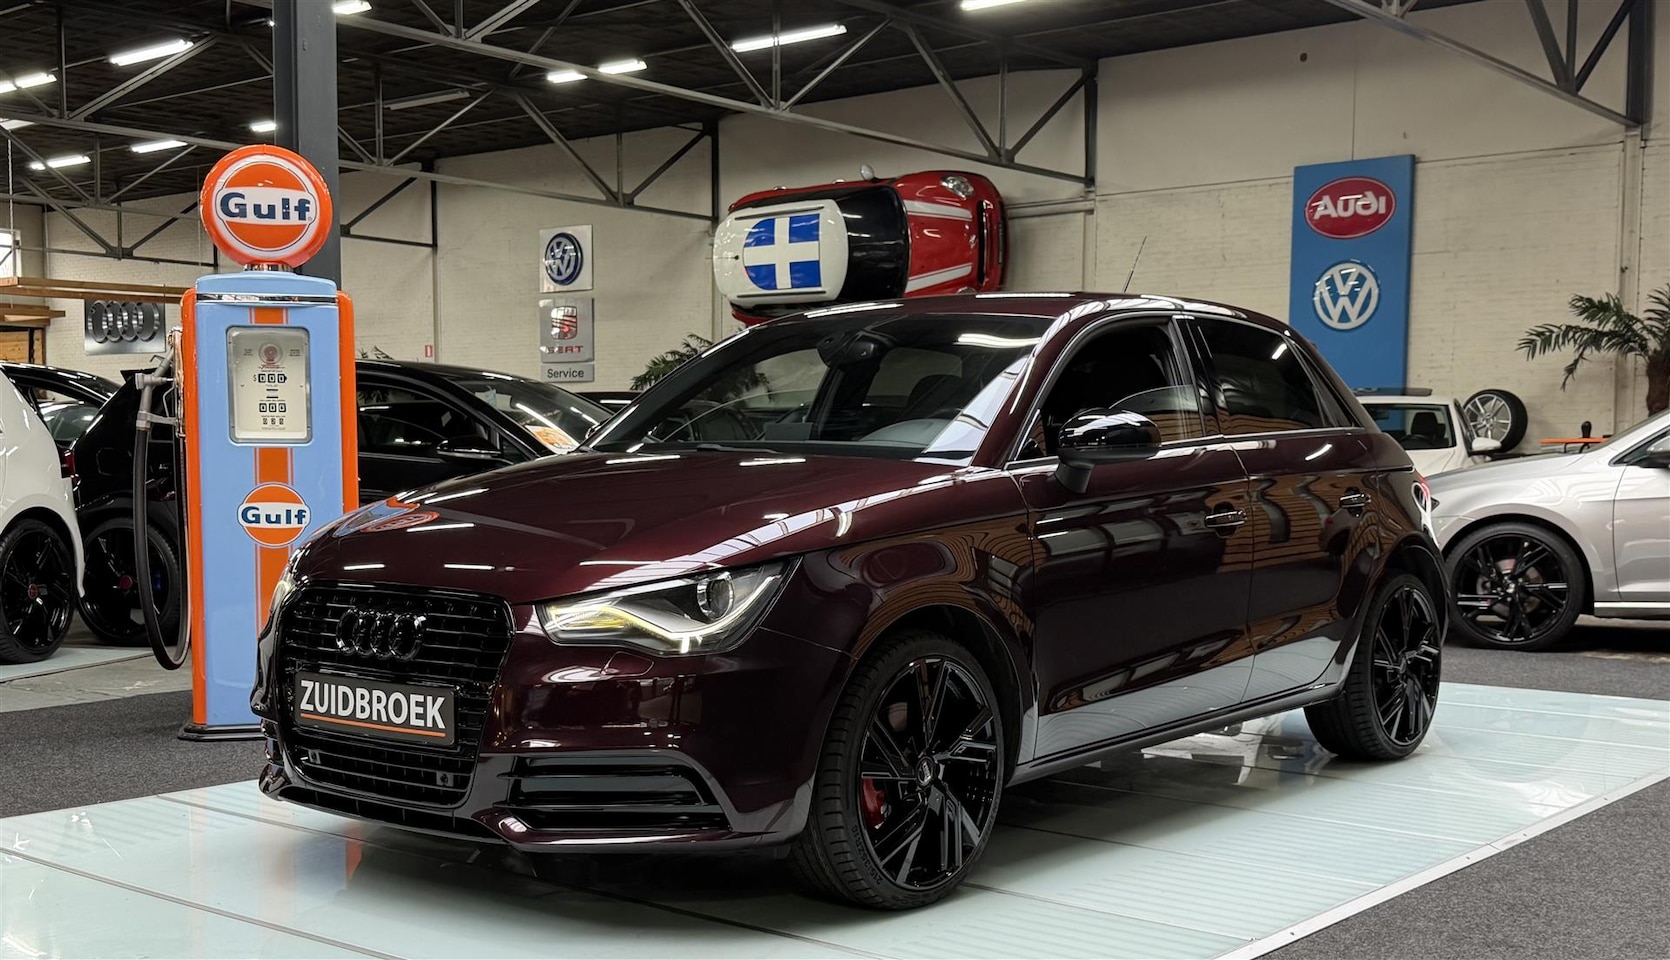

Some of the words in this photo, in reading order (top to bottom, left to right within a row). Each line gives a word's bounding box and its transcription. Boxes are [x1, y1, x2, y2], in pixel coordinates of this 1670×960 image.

[220, 192, 310, 221] Gulf
[1318, 266, 1375, 326] VW
[548, 345, 584, 354] SEAT
[547, 368, 585, 378] Service
[241, 506, 307, 525] Gulf
[300, 679, 446, 729] ZUIDBROEK
